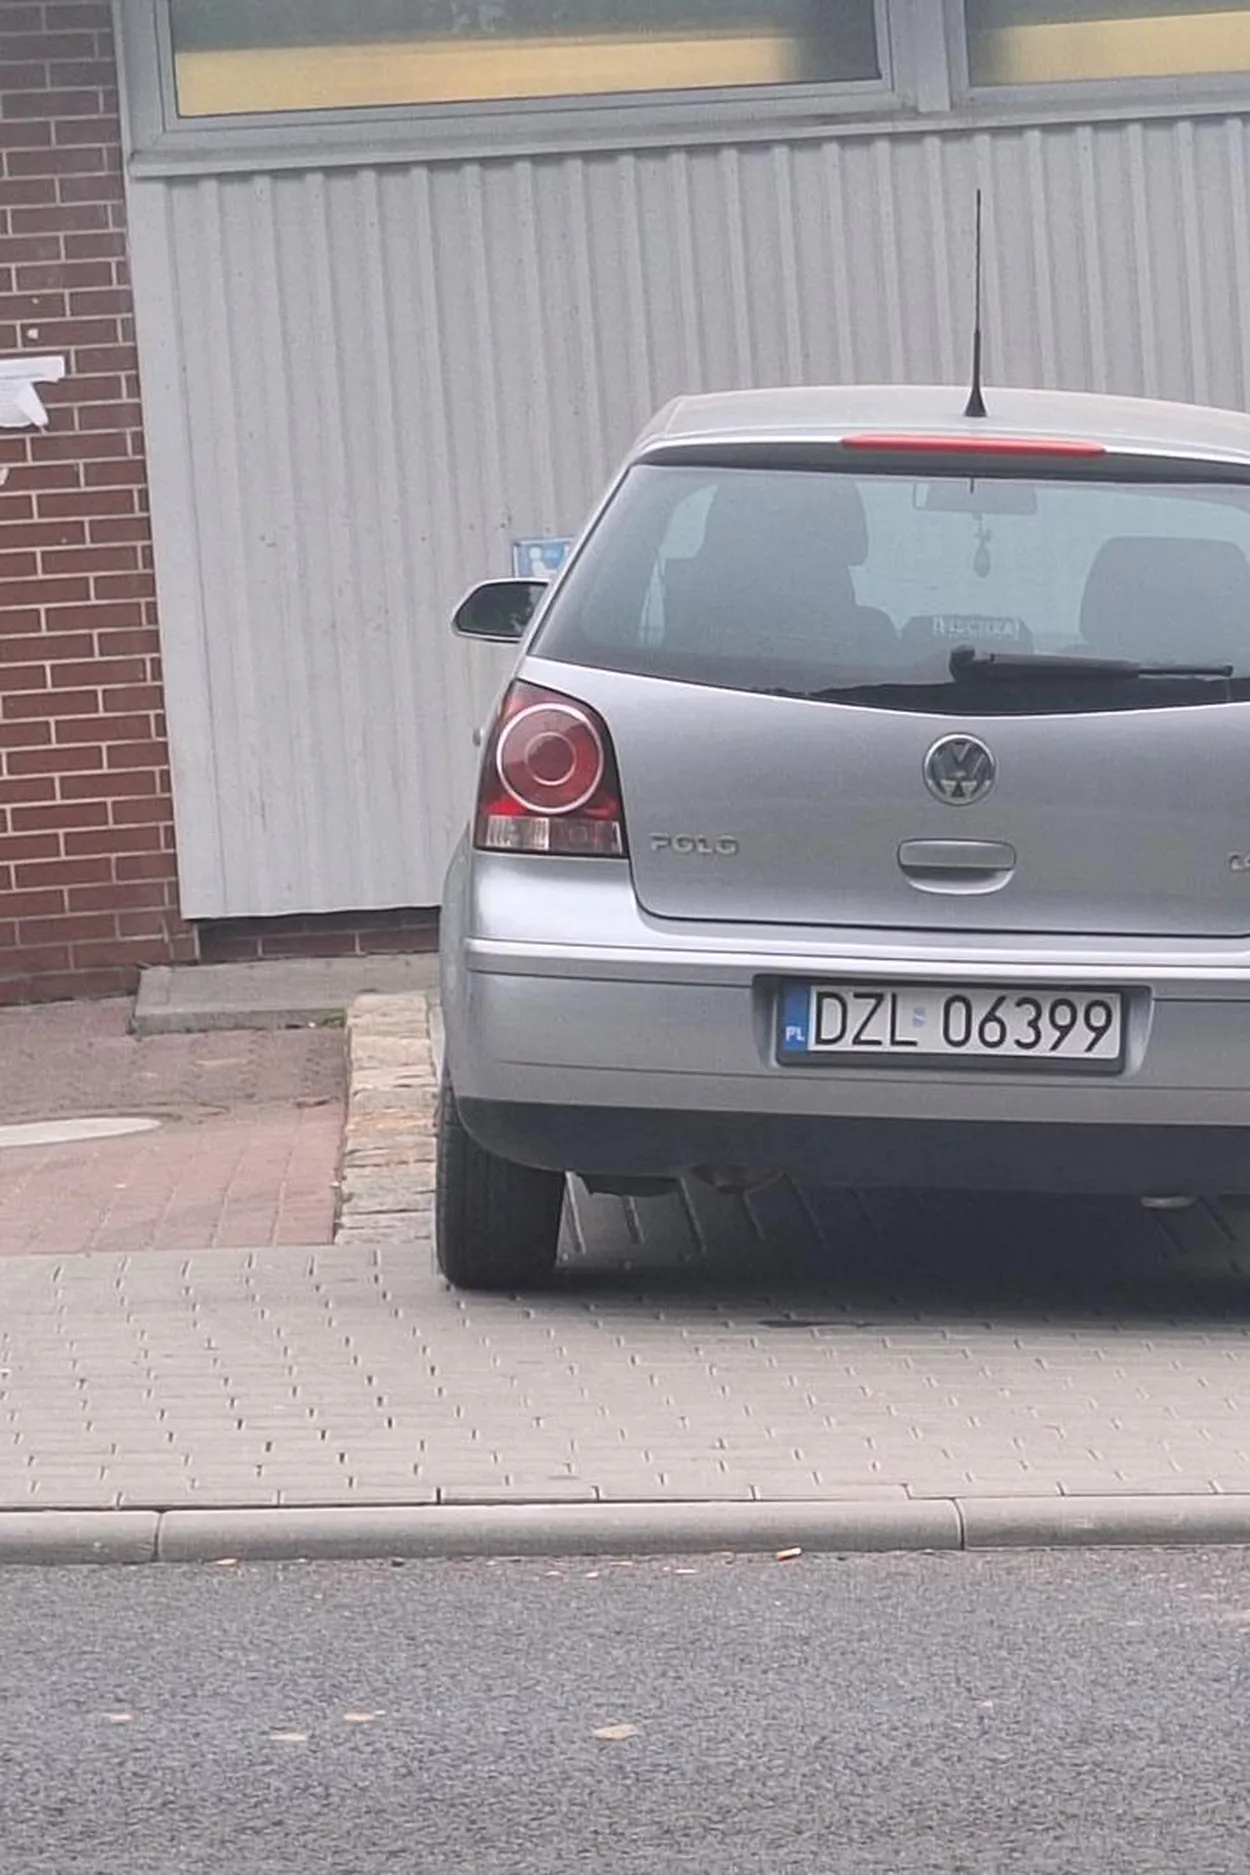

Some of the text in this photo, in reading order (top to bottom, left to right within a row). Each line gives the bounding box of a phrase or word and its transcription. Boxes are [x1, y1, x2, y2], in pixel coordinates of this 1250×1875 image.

[648, 831, 740, 855] POLO
[785, 990, 1114, 1053] PL DZL 06399
